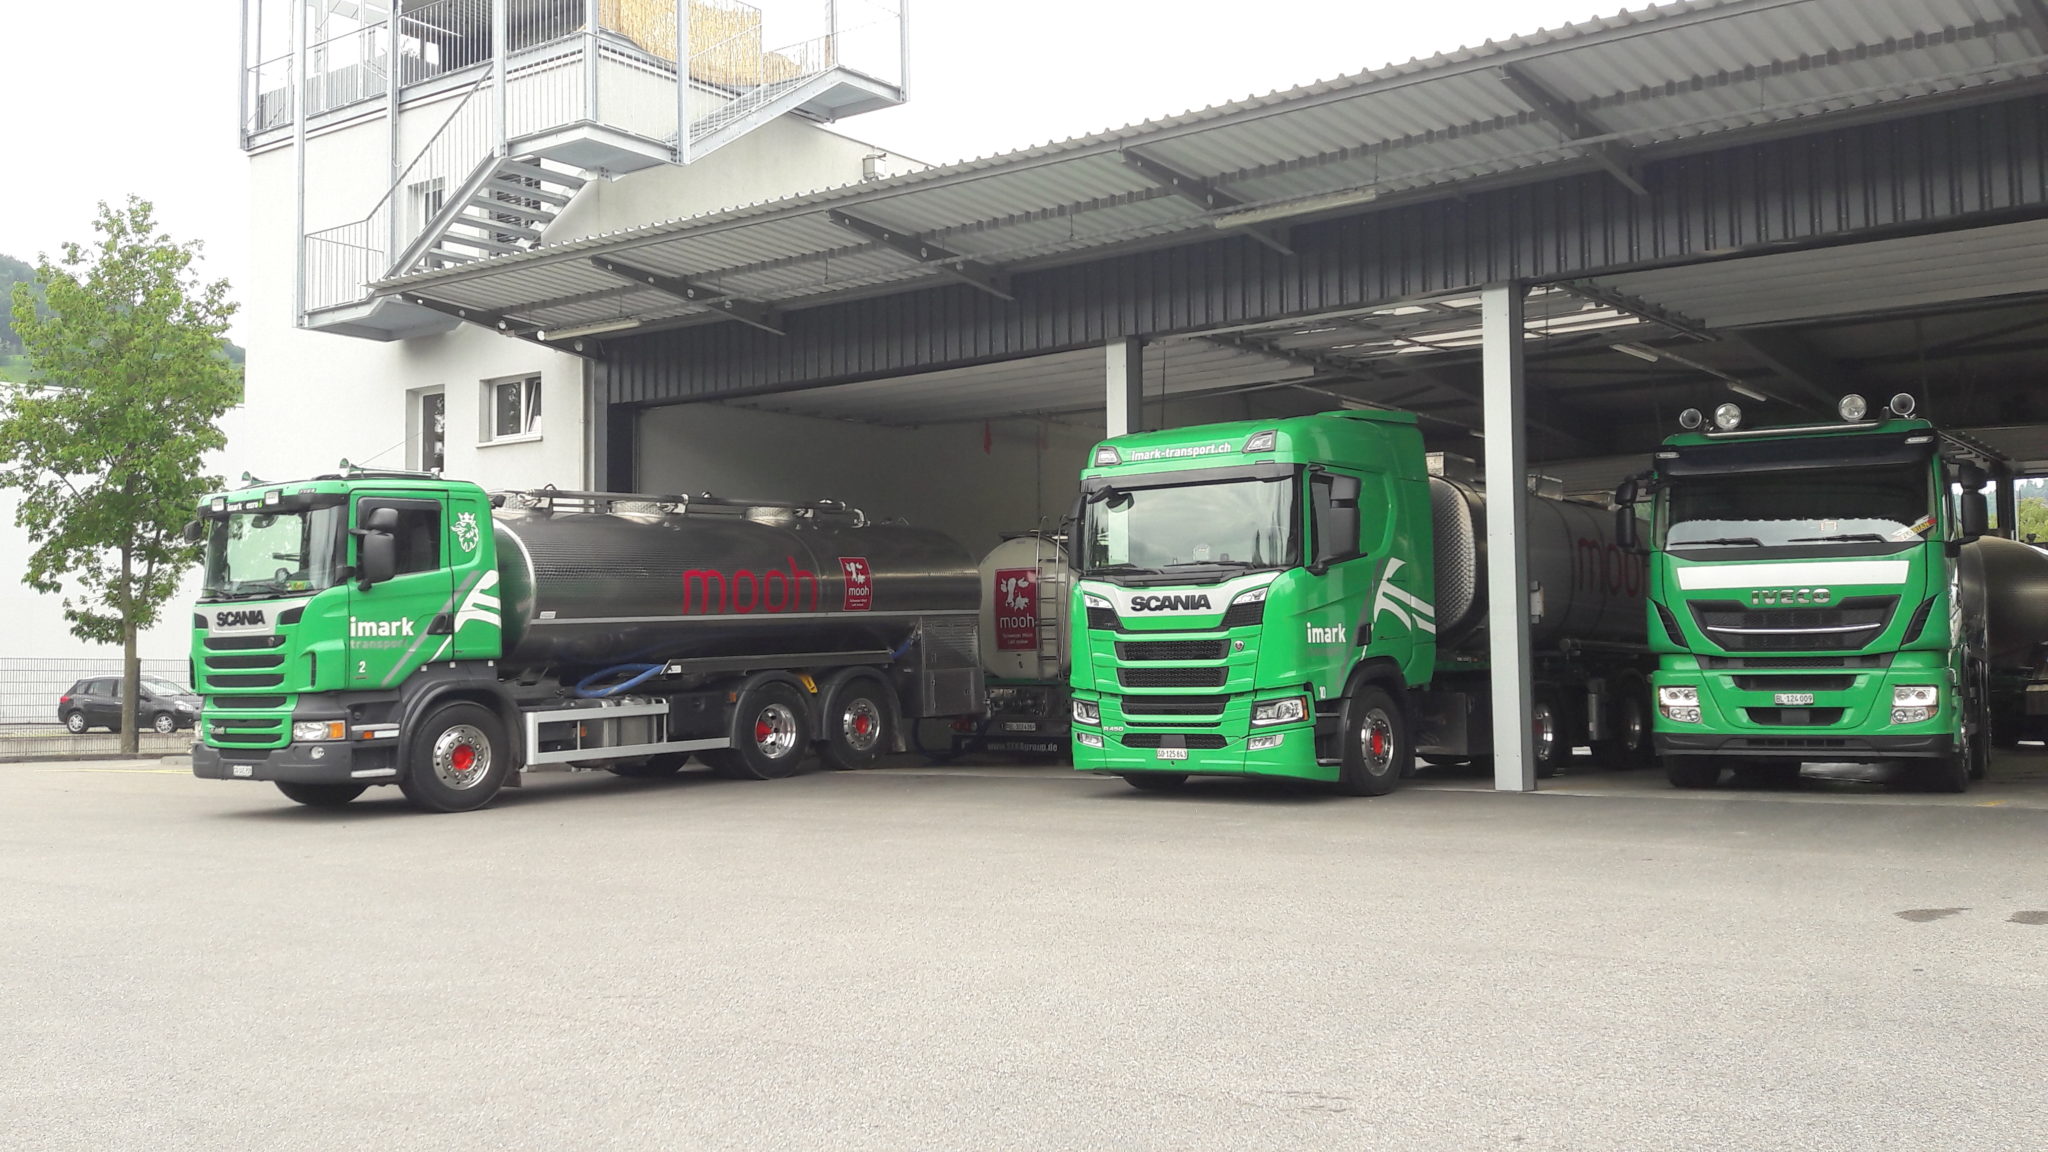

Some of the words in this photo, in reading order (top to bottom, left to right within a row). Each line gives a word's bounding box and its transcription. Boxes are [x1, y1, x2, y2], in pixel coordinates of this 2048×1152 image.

[682, 555, 817, 614] mooh
[848, 585, 870, 596] mooh
[1131, 594, 1212, 612] SCANIA
[1752, 588, 1831, 605] IVECO
[216, 610, 266, 627] SCANIA
[350, 616, 415, 637] imark
[1000, 612, 1035, 629] mooh
[1307, 622, 1347, 643] imark
[358, 660, 366, 673] 2
